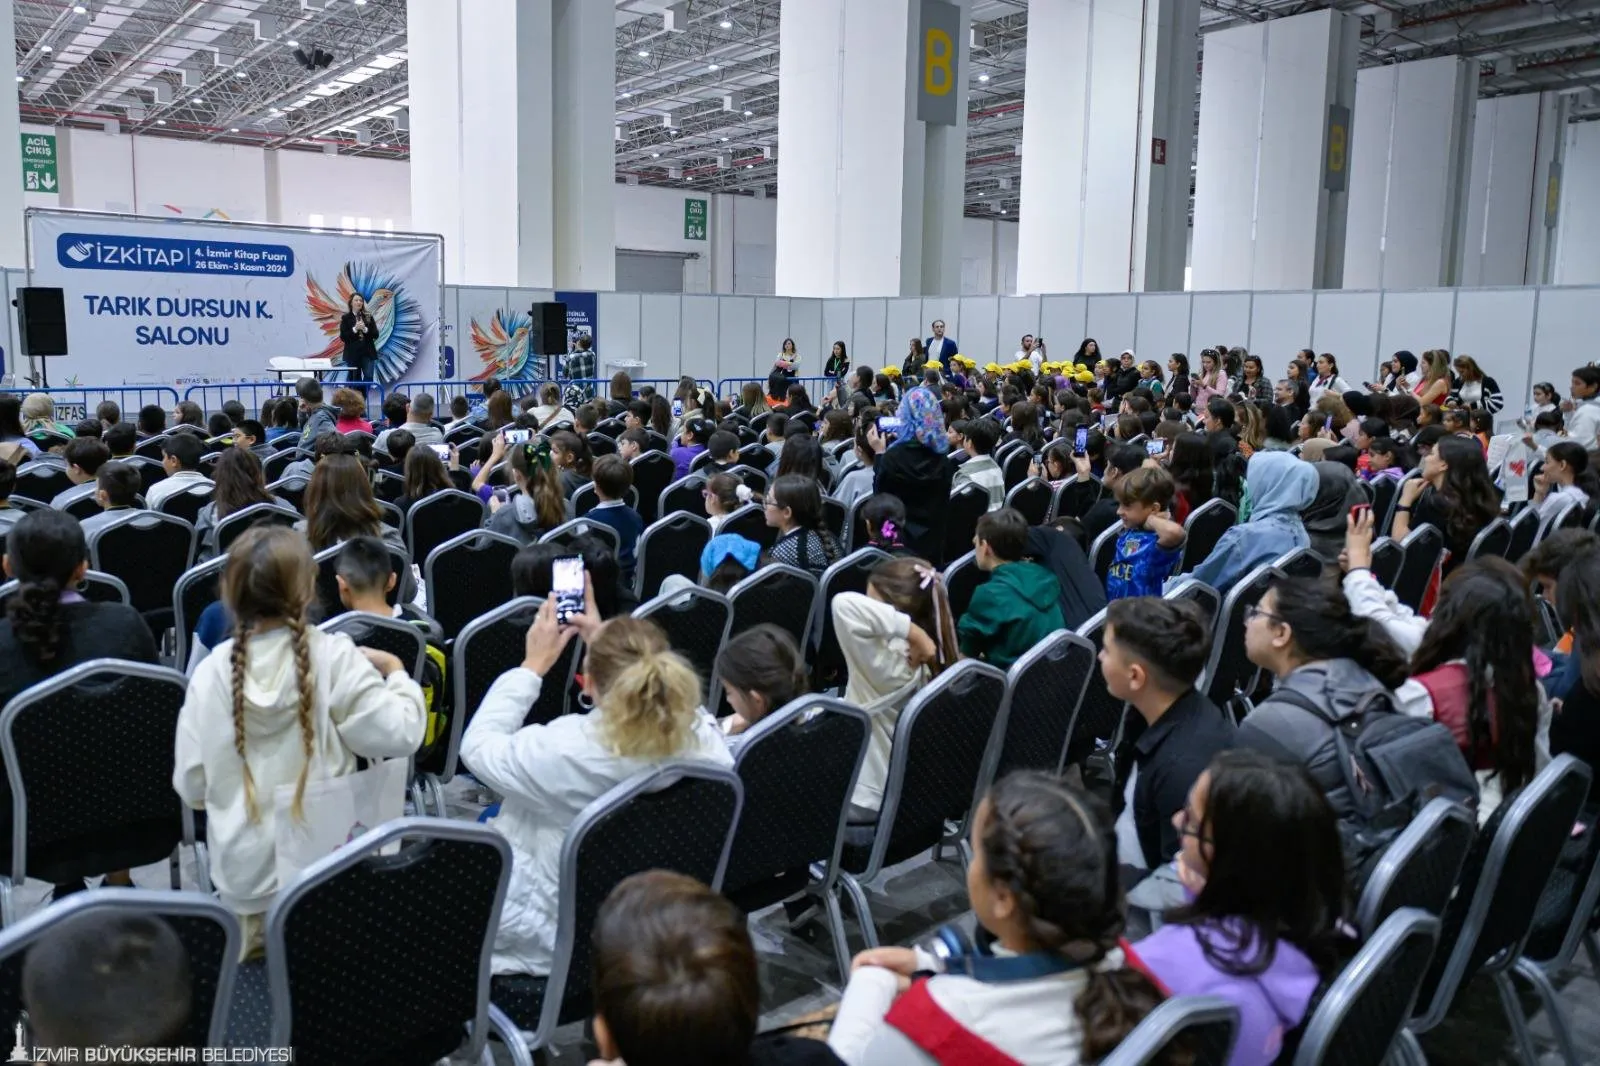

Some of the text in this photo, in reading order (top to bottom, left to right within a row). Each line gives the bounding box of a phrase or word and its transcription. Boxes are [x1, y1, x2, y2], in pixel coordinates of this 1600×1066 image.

[924, 27, 953, 96] B
[27, 137, 50, 146] ACİL
[1328, 124, 1347, 172] B
[97, 242, 184, 266] İZKİTAP
[194, 245, 287, 262] 4. İzmir Kitap Fuarı
[195, 261, 207, 269] 26
[240, 263, 266, 272] Kasım
[266, 264, 287, 273] 2024
[83, 295, 274, 319] TARIK DURSUN K.
[136, 325, 230, 345] SALONU
